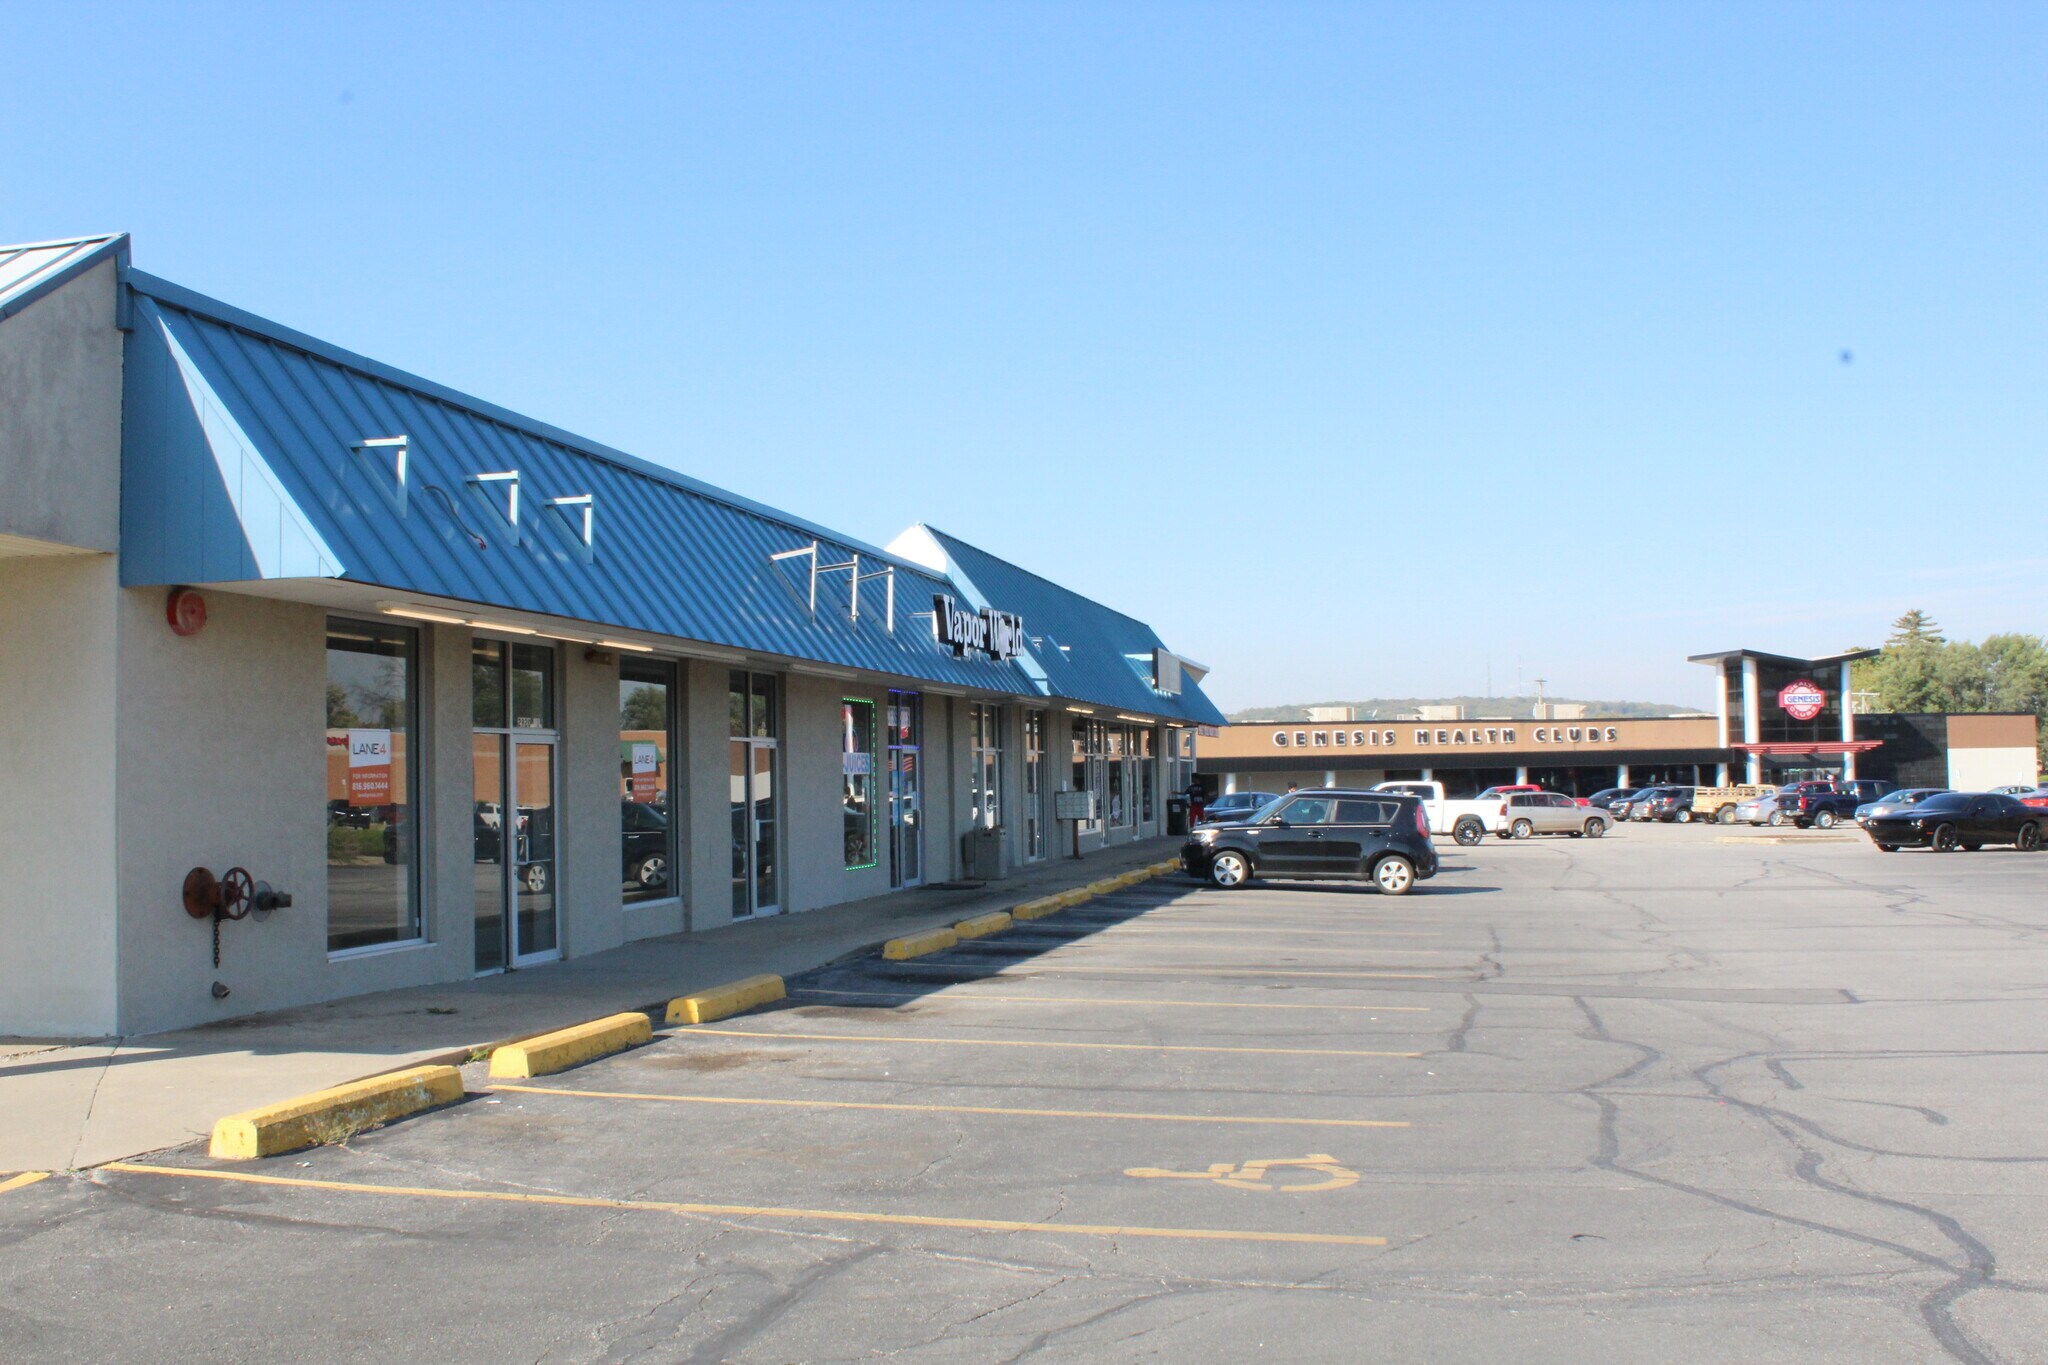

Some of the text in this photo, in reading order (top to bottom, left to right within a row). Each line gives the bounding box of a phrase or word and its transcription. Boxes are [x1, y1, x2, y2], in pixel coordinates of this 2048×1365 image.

[943, 594, 1023, 660] Vapor World
[1787, 695, 1820, 703] GENESIS
[1790, 706, 1817, 718] CLUBS
[1273, 726, 1617, 747] GENESIS HEALTH CLUBS
[352, 743, 387, 755] LANE4
